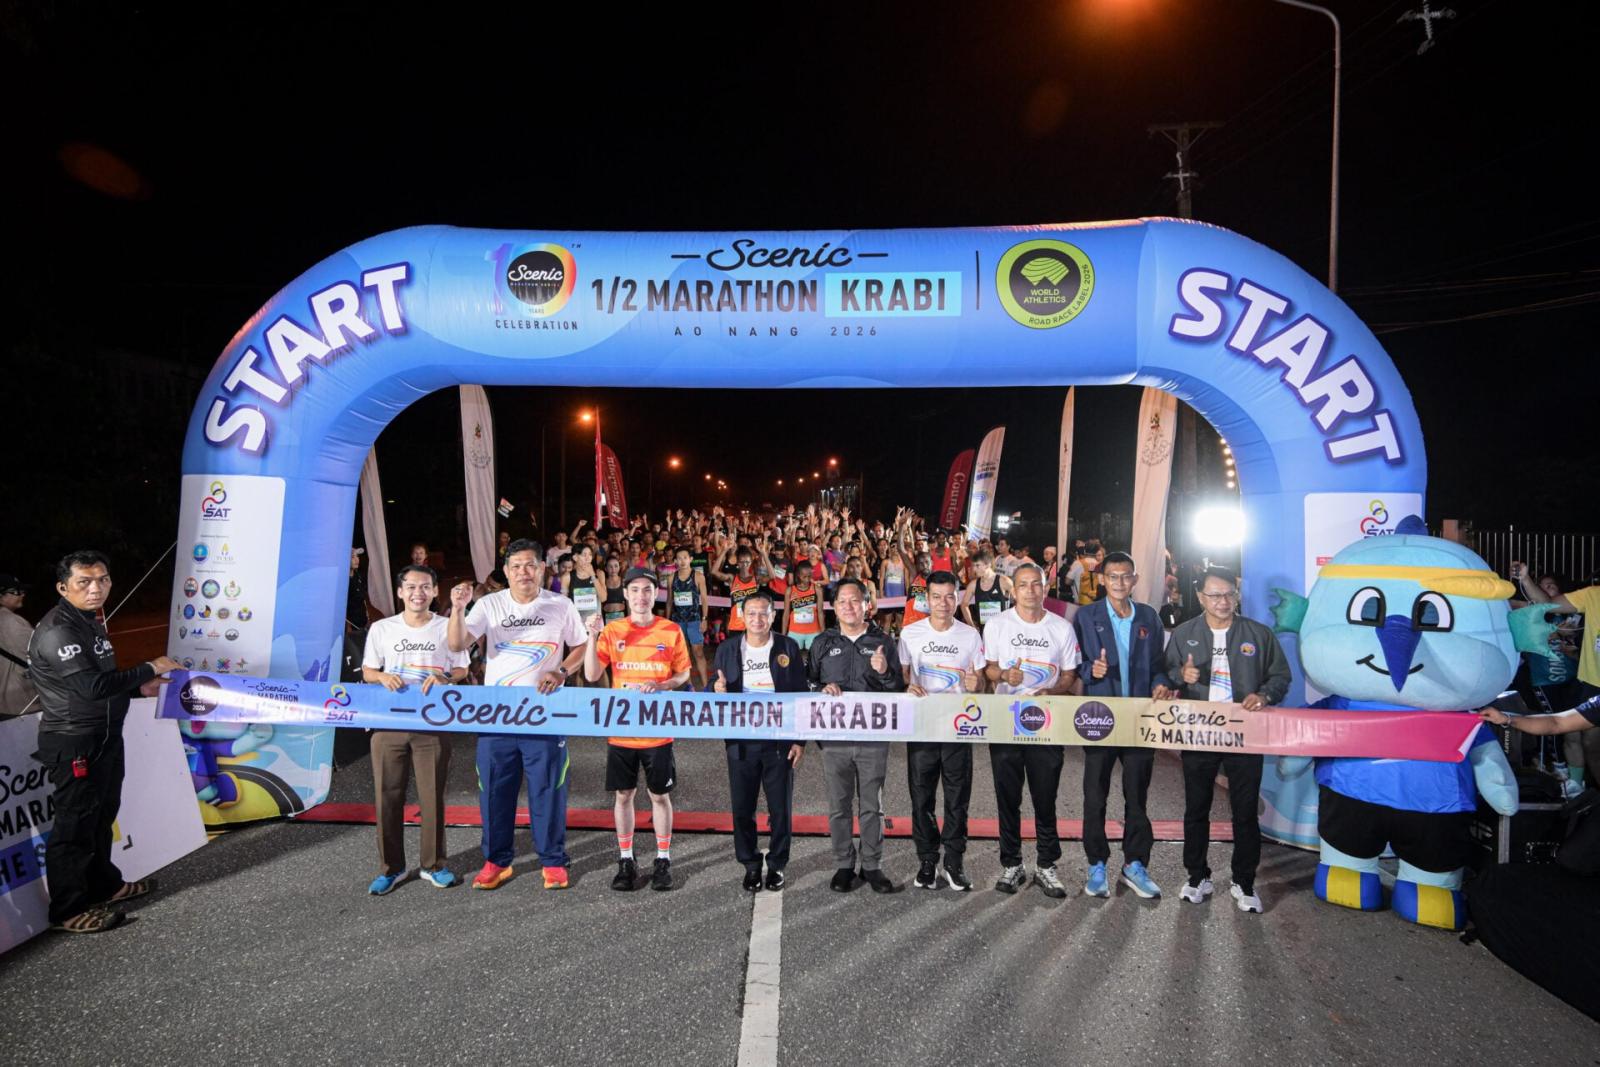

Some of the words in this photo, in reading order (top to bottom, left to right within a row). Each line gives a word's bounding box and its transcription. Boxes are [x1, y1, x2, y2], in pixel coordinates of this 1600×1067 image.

[707, 239, 852, 271] Scenic
[508, 264, 564, 281] Scenic
[591, 278, 639, 315] 1/2
[648, 278, 818, 313] MARATHON
[840, 277, 946, 312] KRABI
[1030, 288, 1060, 296] WORLD
[1023, 296, 1067, 304] ATHLETICS
[1028, 317, 1051, 325] ROAD
[1053, 308, 1073, 323] RACE
[1073, 287, 1090, 311] LABEL
[495, 319, 579, 331] CELEBRATION
[674, 326, 702, 337] AO
[728, 325, 800, 337] NANG
[830, 325, 877, 337] 2026
[203, 263, 409, 454] START
[1171, 270, 1401, 461] START
[203, 507, 232, 518] SAT
[501, 614, 546, 628] Scenic
[394, 638, 437, 652] Scenic
[922, 641, 959, 654] Scenic
[1011, 633, 1050, 648] Scenic
[741, 659, 770, 672] Scen
[255, 682, 289, 693] Scenic
[325, 710, 358, 721] SAT
[421, 690, 547, 727] Scenic
[590, 695, 631, 728] 1/2
[638, 699, 784, 729] MARATHON
[809, 700, 899, 731] KRABI
[1020, 712, 1045, 722] Scenic
[1157, 705, 1227, 727] Scenic
[1074, 712, 1114, 726] Scenic
[957, 725, 988, 737] SAT
[1162, 728, 1245, 748] MARATHON
[0, 765, 58, 805] Scen
[0, 794, 56, 840] MARA
[0, 851, 28, 885] HE
